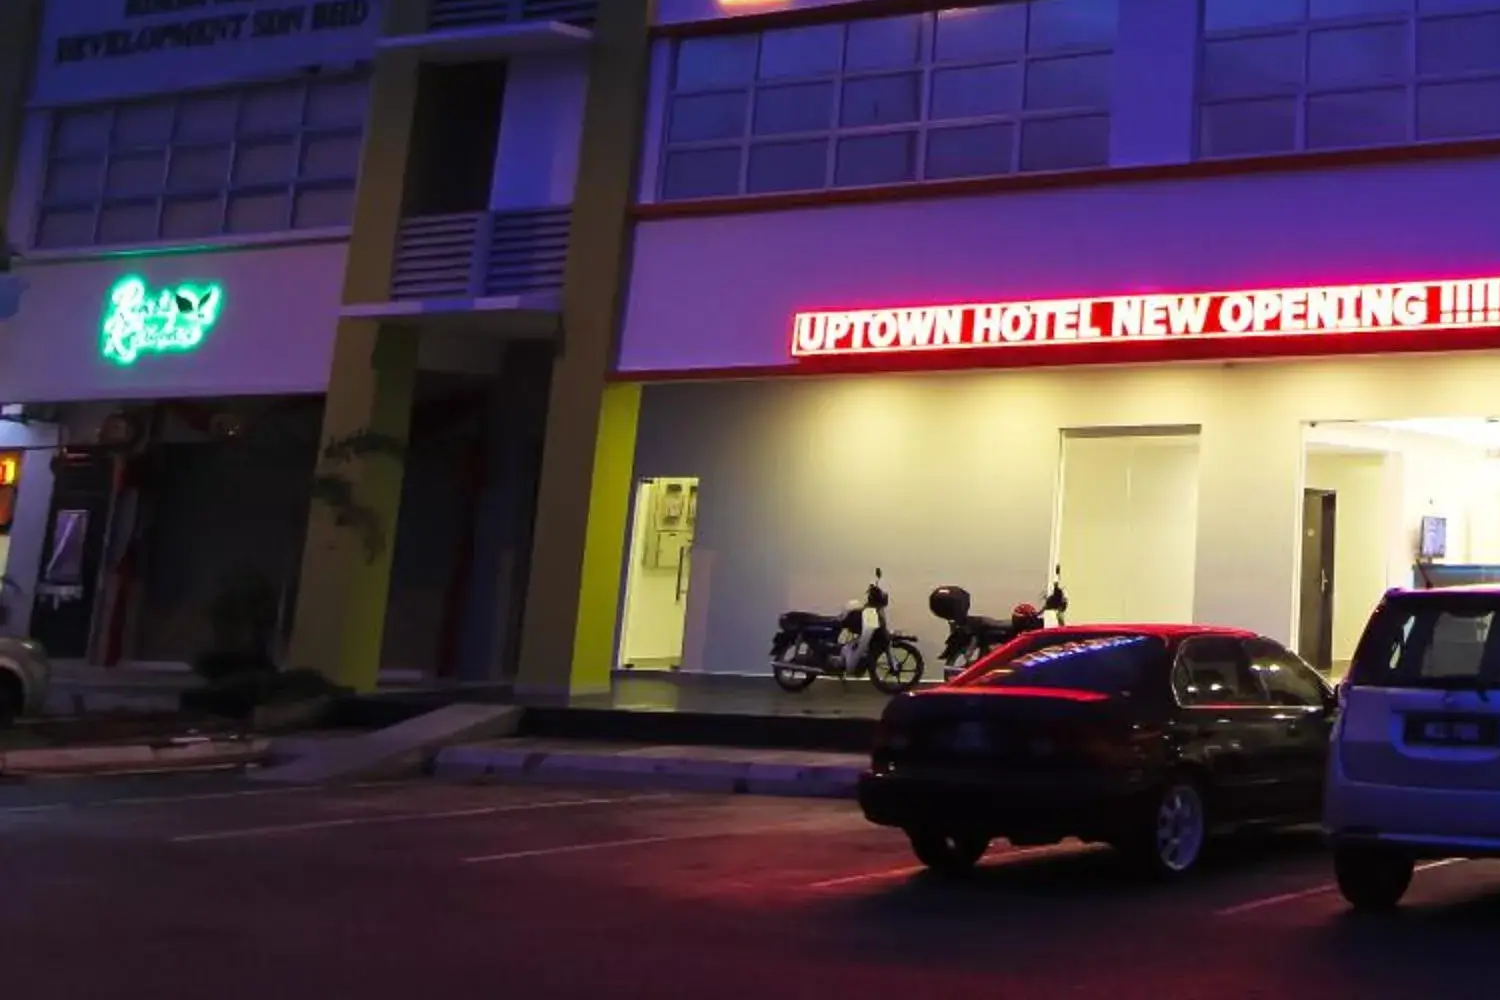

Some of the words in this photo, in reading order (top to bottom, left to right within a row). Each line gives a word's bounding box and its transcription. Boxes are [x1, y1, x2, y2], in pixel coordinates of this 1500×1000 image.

[56, 15, 247, 62] DEVELOPMENT
[799, 307, 962, 350] UPTOWN
[973, 301, 1101, 343] HOTEL
[1111, 296, 1210, 338] NEW
[1218, 285, 1428, 332] OPENING
